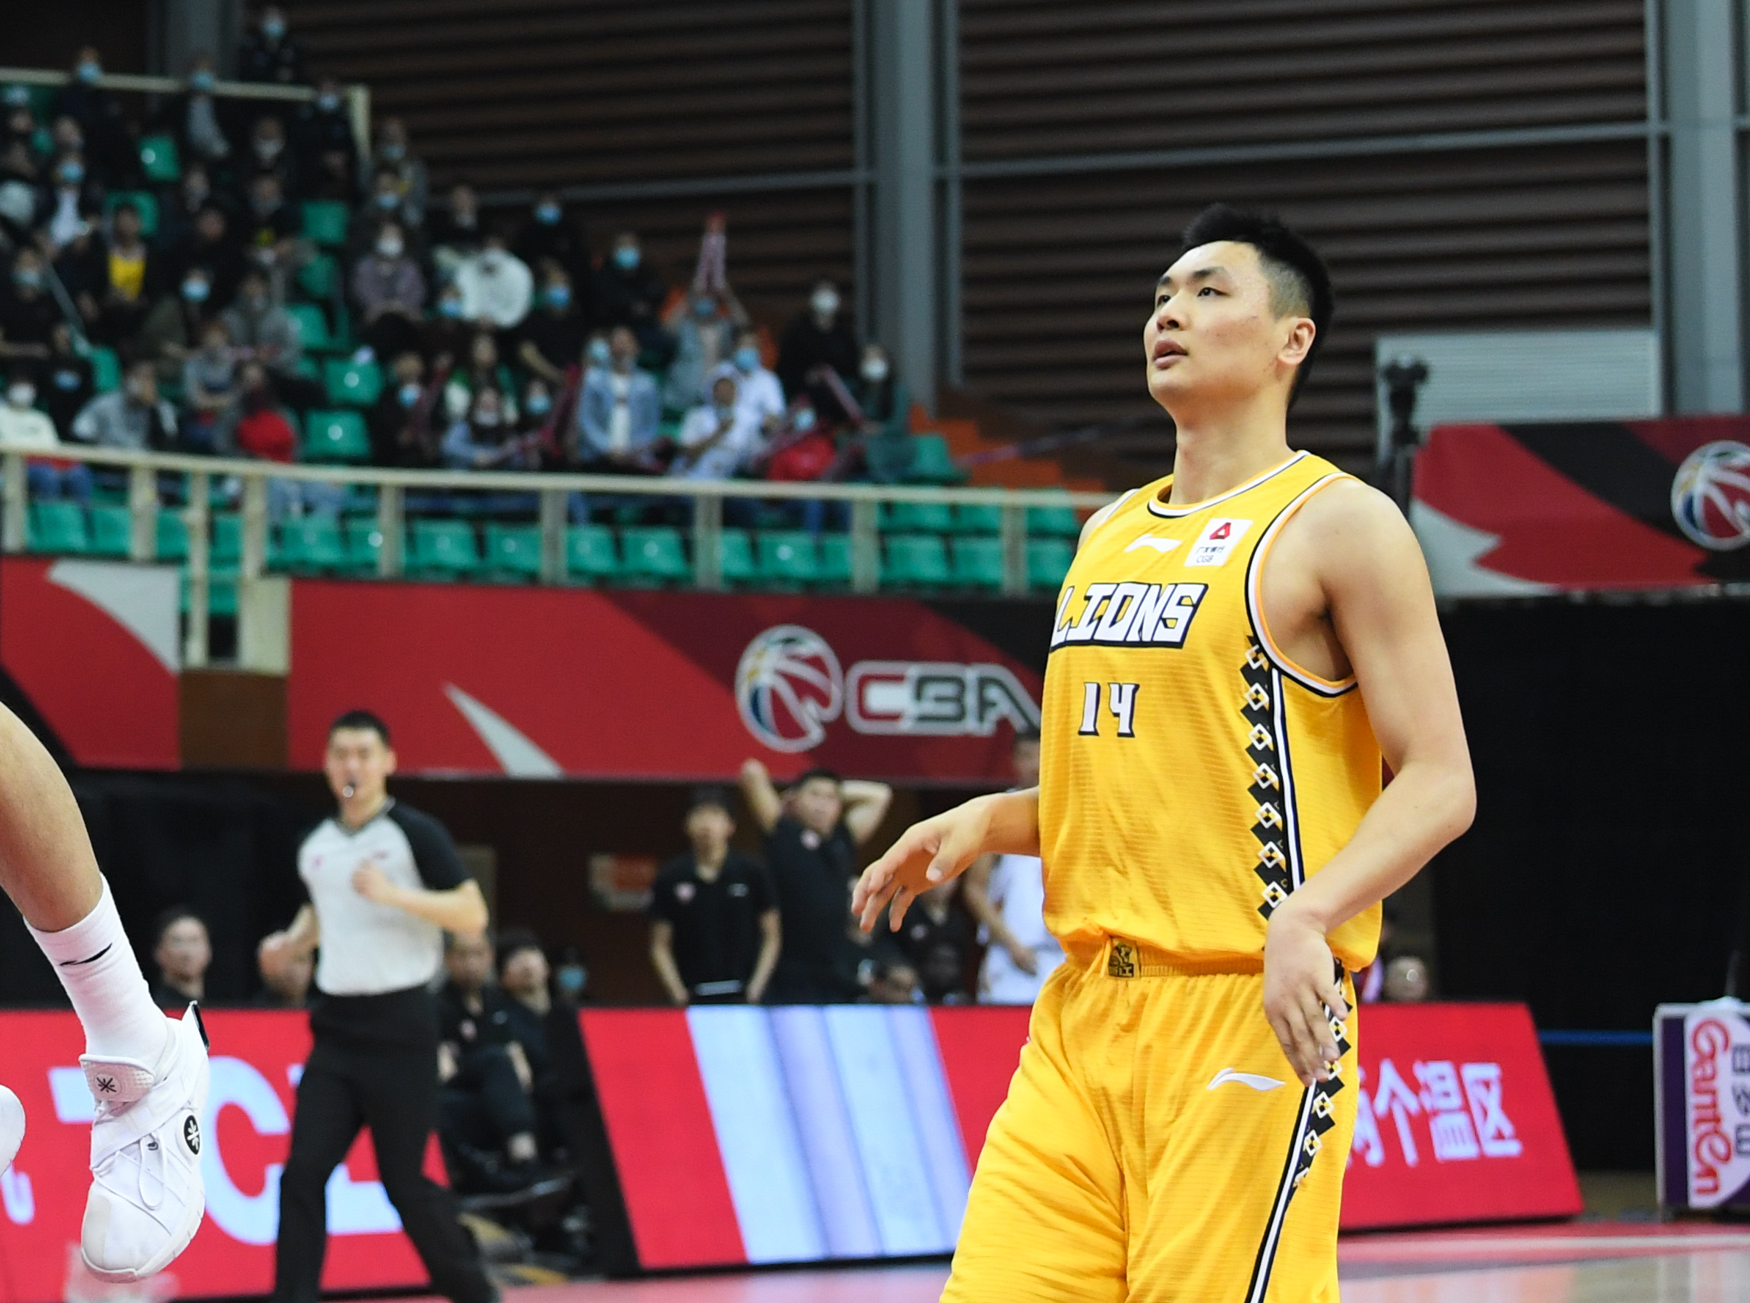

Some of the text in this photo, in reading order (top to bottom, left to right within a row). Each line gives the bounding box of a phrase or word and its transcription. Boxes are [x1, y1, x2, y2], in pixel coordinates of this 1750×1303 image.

[1050, 581, 1209, 651] LIONS
[845, 659, 1041, 737] CBA
[1078, 681, 1140, 738] 14
